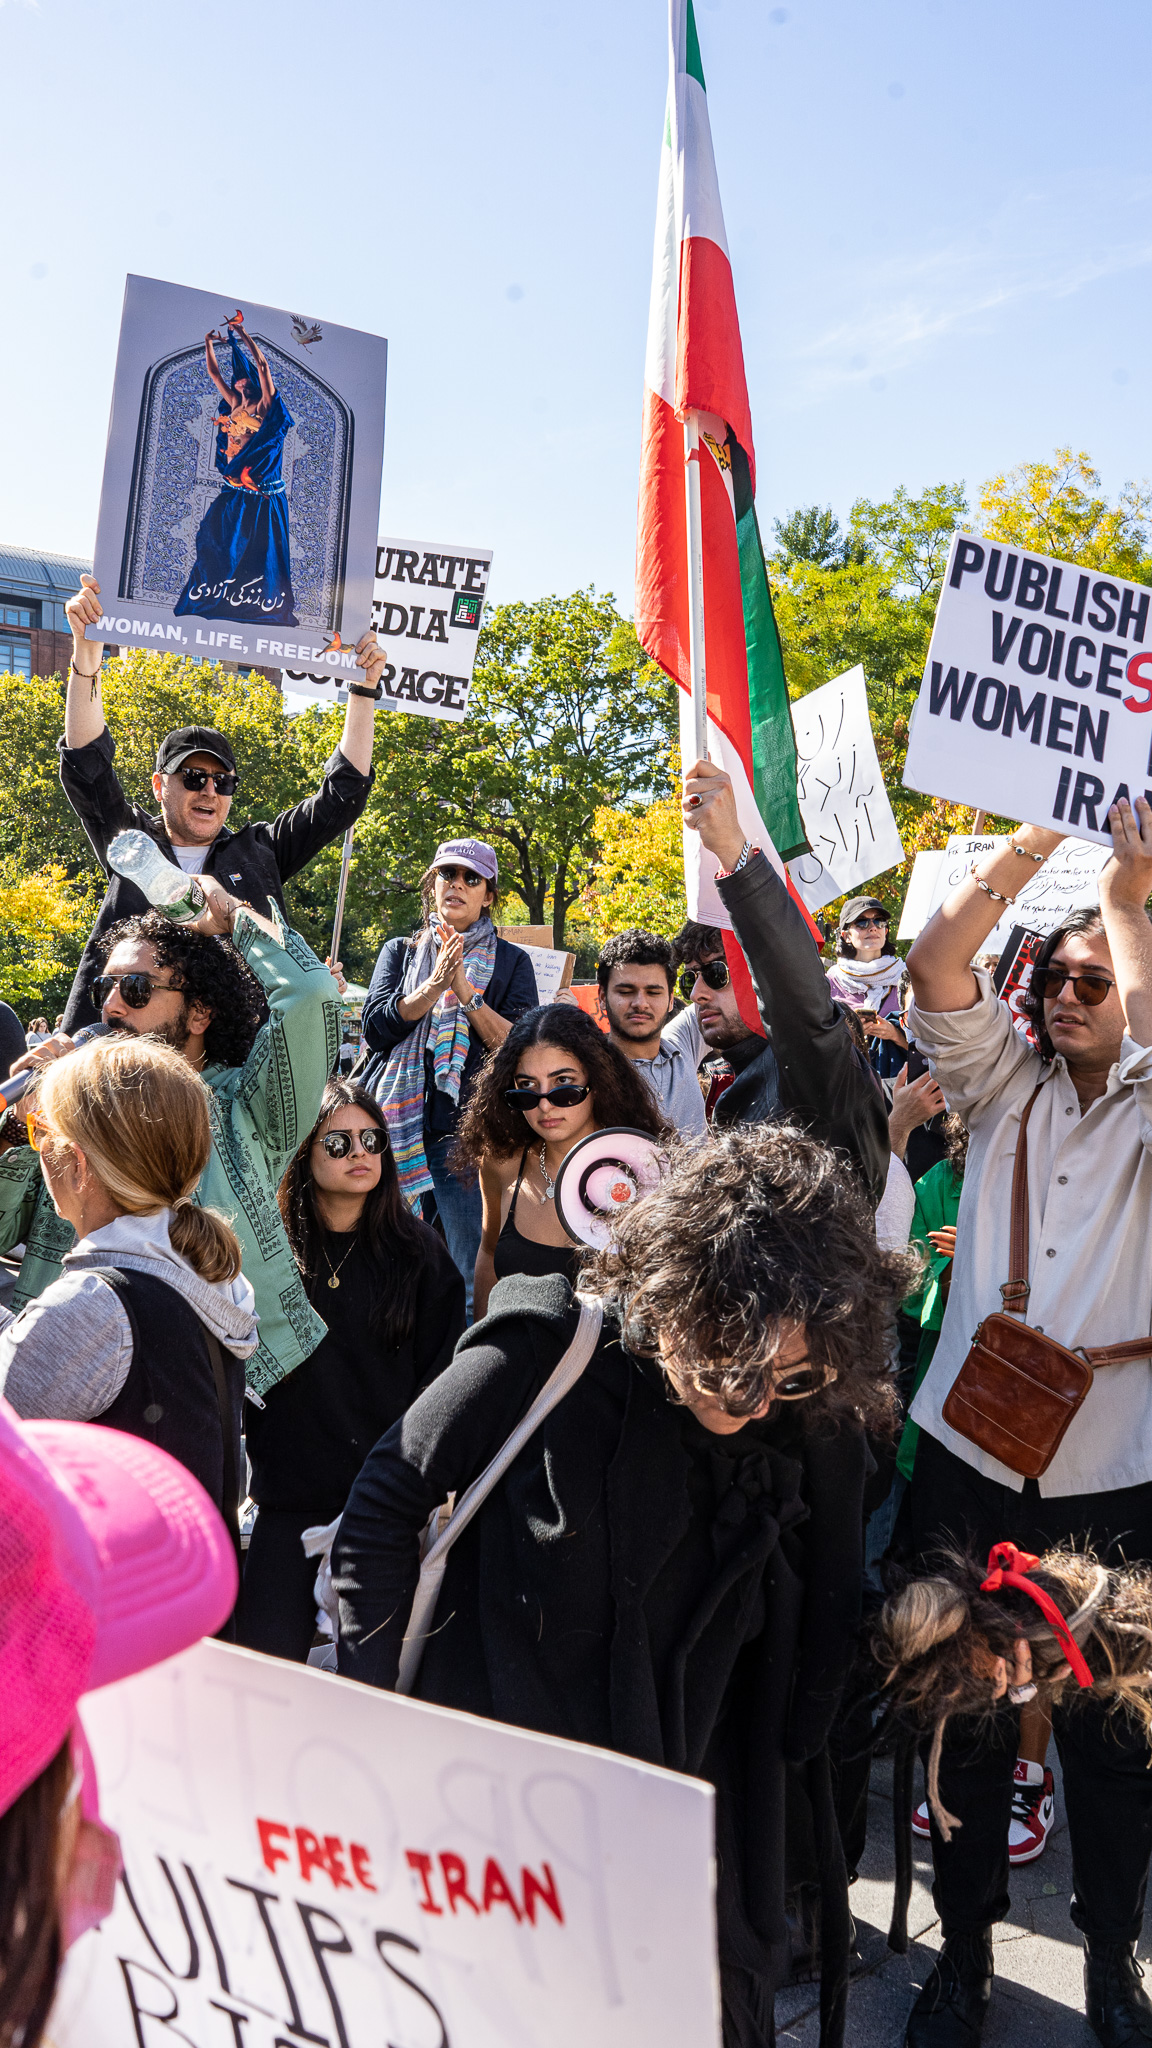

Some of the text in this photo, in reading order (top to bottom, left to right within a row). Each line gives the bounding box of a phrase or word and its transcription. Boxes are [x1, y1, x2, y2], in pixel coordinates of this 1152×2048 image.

[96, 615, 358, 671] WOMAN, LIFE, FREEDOM
[949, 539, 1151, 643] PUBLISH
[929, 661, 1110, 764] WOMEN
[991, 610, 1152, 714] VOICES
[964, 840, 995, 854] IRAN
[255, 1817, 566, 1929] FREE IRAN
[95, 1854, 452, 2048] ULIPS
